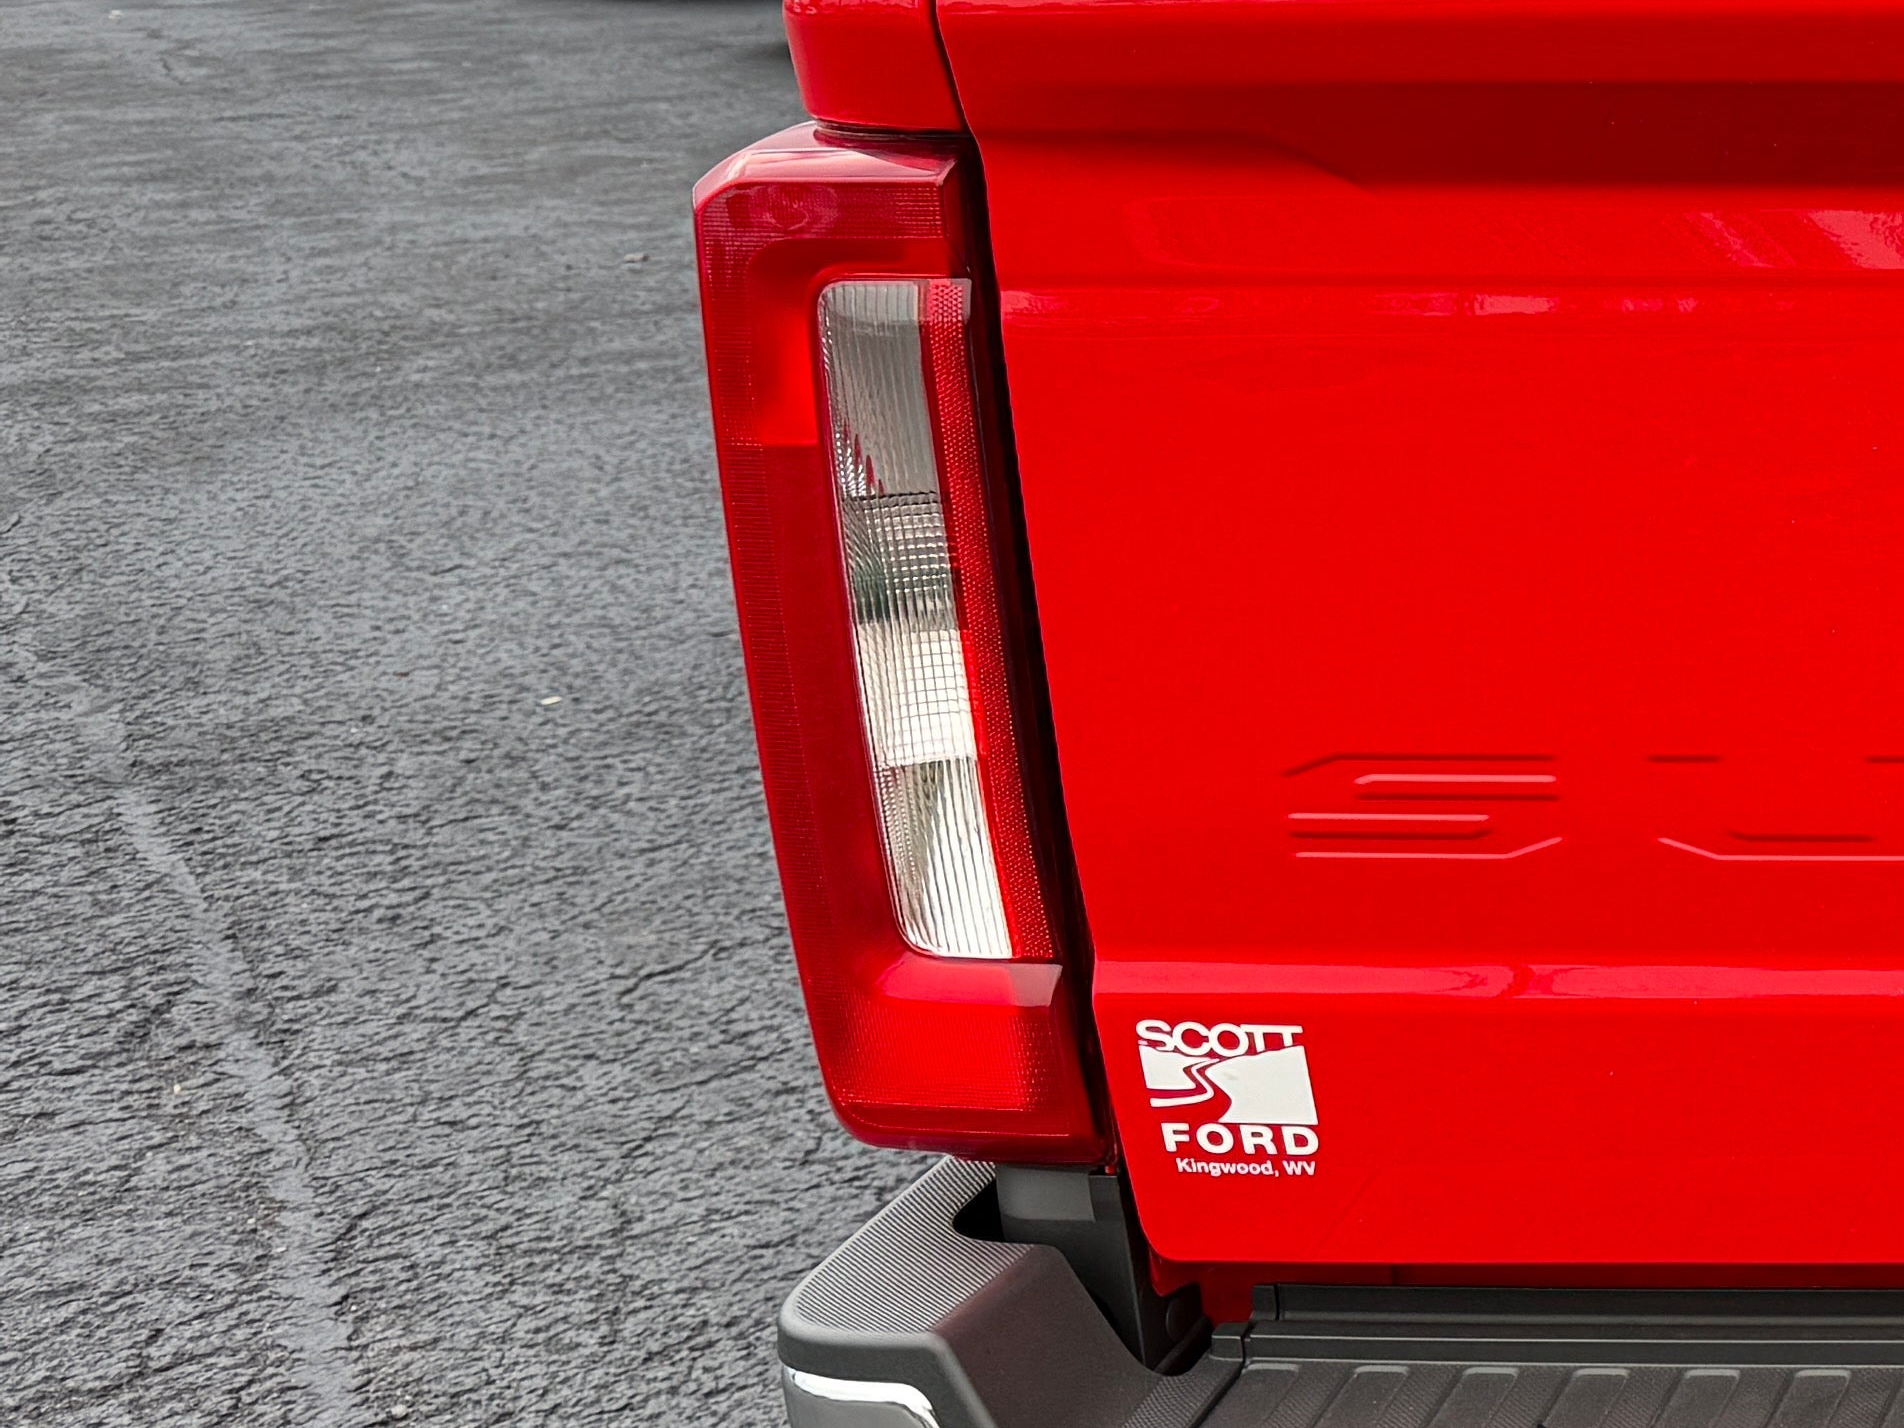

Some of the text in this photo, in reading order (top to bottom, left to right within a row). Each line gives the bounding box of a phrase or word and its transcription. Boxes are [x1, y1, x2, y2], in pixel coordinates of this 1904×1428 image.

[1136, 1019, 1304, 1057] SCOTT
[1161, 1123, 1319, 1155] FORD
[1176, 1158, 1316, 1177] Kingwood, WV
